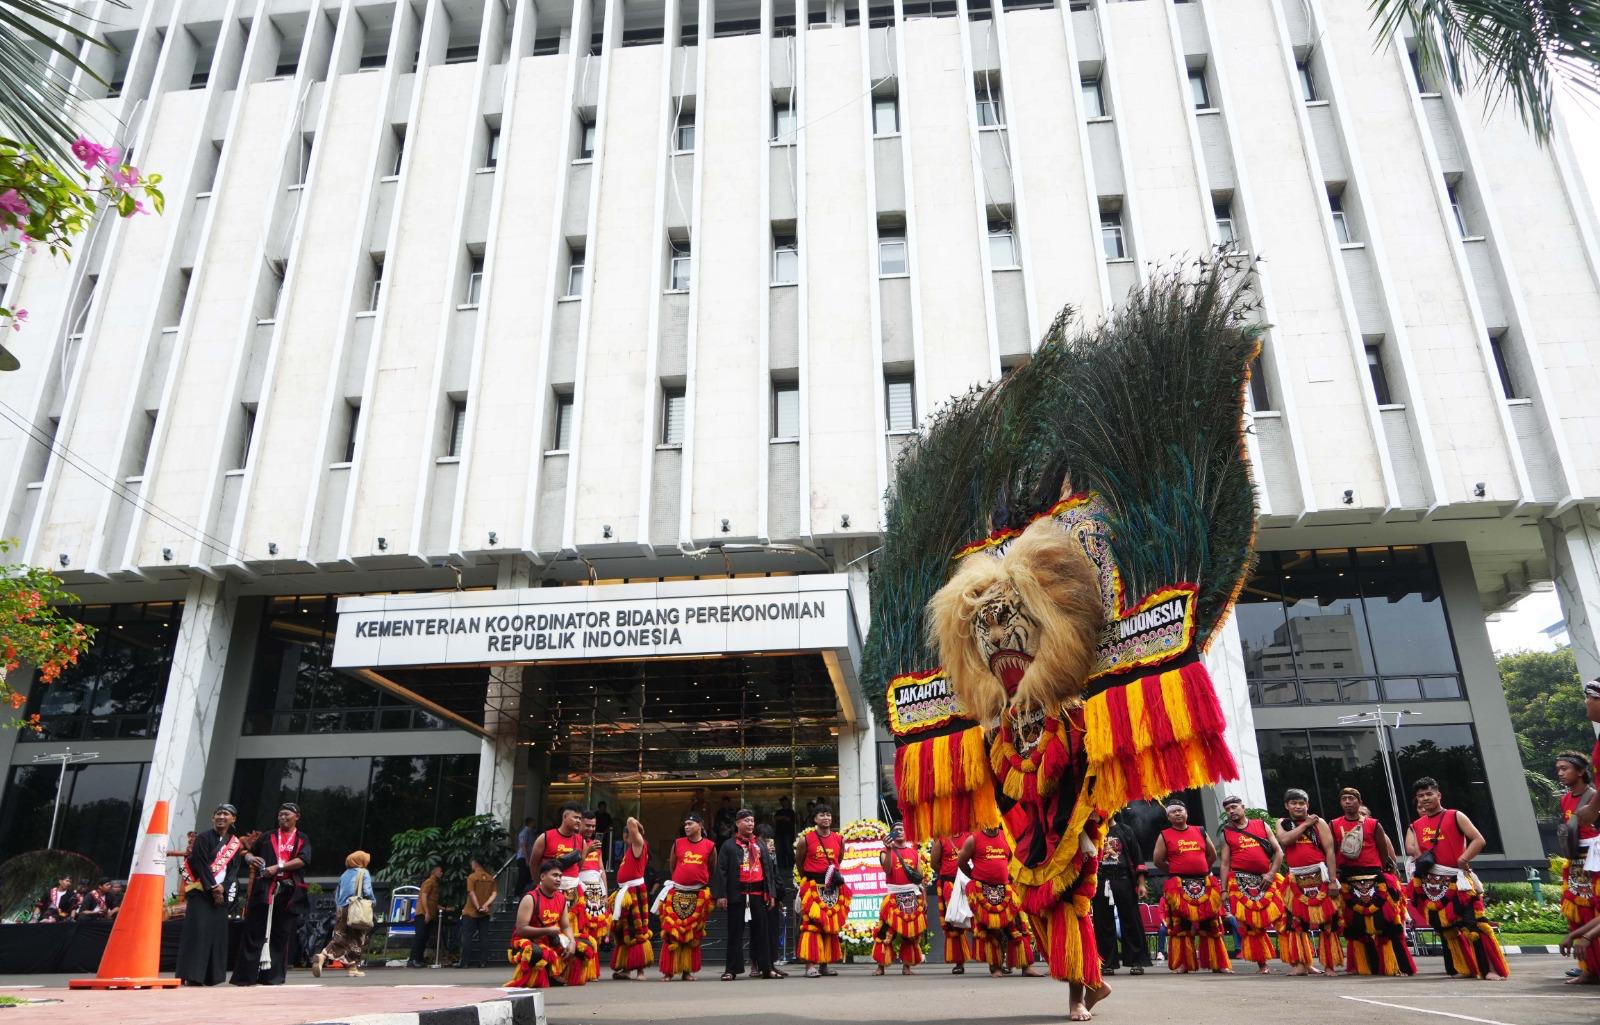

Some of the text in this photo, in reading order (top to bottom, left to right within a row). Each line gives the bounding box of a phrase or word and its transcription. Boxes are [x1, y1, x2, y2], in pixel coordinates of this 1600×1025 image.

[355, 601, 825, 638] KEMENTERIAN KOORDINATOR BIDANG PEREKONOMIAN
[1120, 599, 1184, 639] INDONESIA
[487, 627, 682, 652] REPUBLIK INDONESIA
[896, 679, 947, 706] JAKARTA
